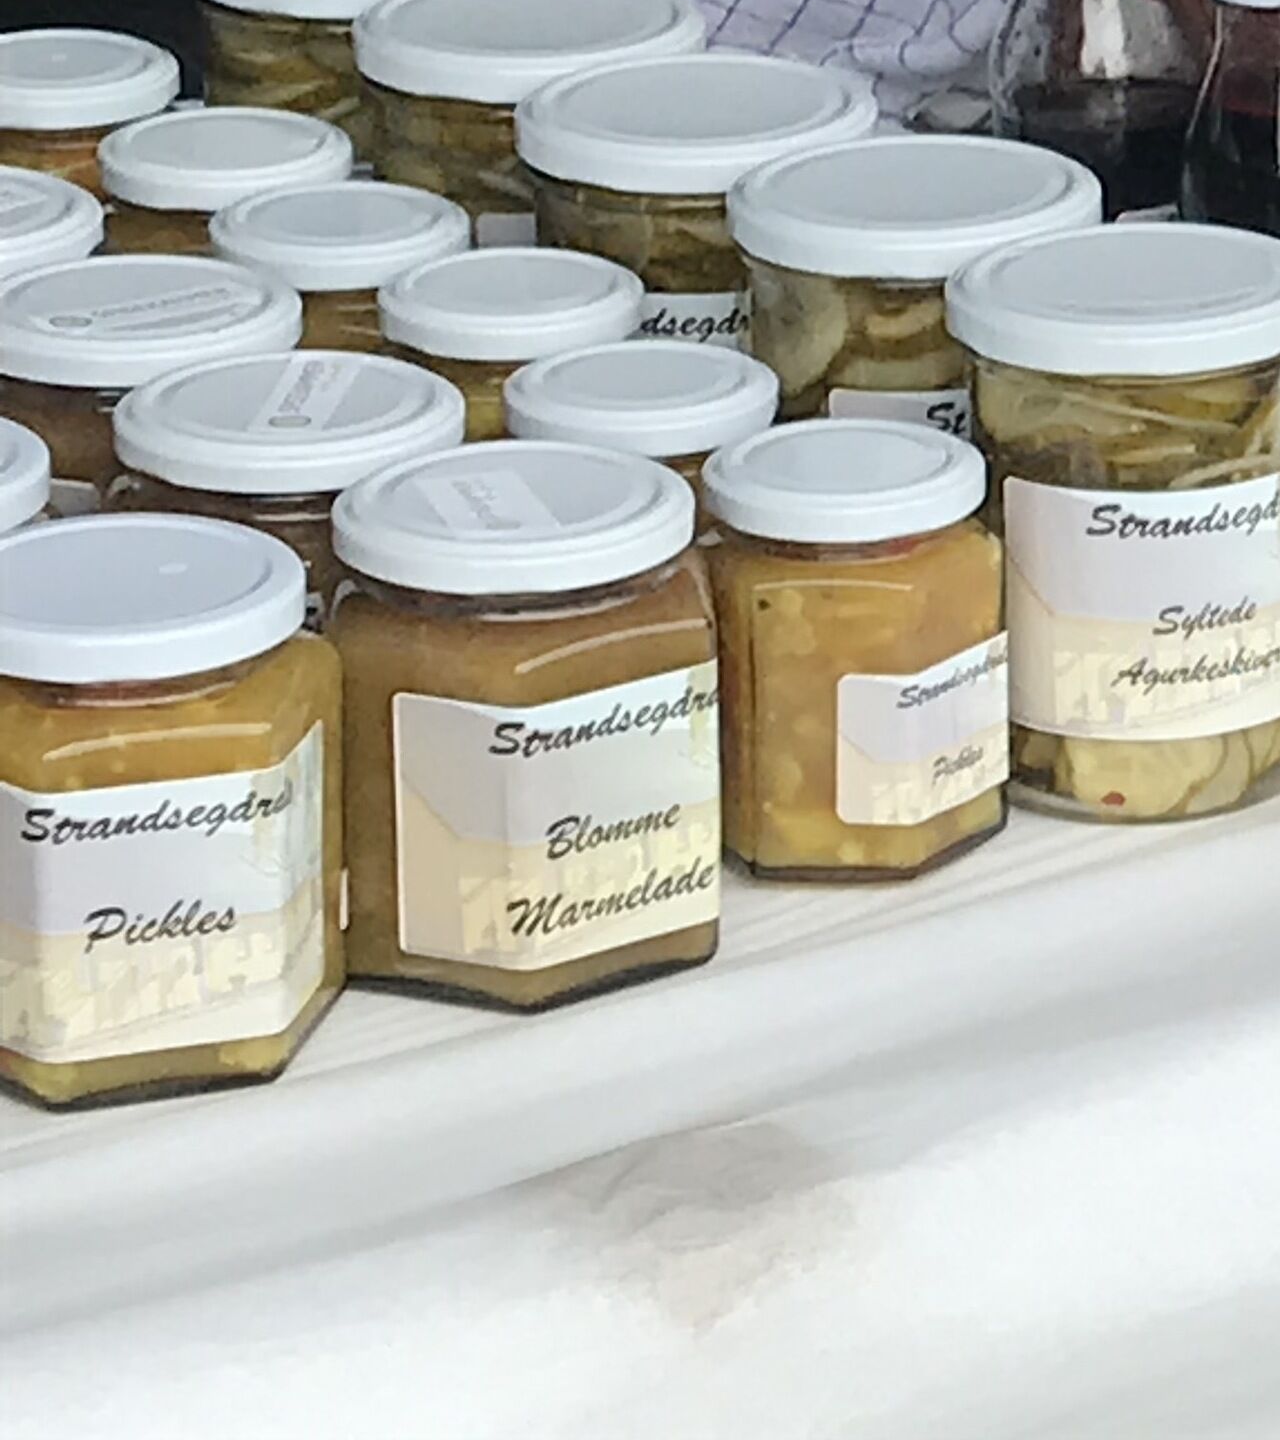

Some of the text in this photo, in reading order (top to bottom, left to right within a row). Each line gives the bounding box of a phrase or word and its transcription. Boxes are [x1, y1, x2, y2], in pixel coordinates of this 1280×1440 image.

[545, 803, 681, 861] Blomme
[506, 855, 716, 938] Marmelade
[83, 898, 237, 954] Pickles
